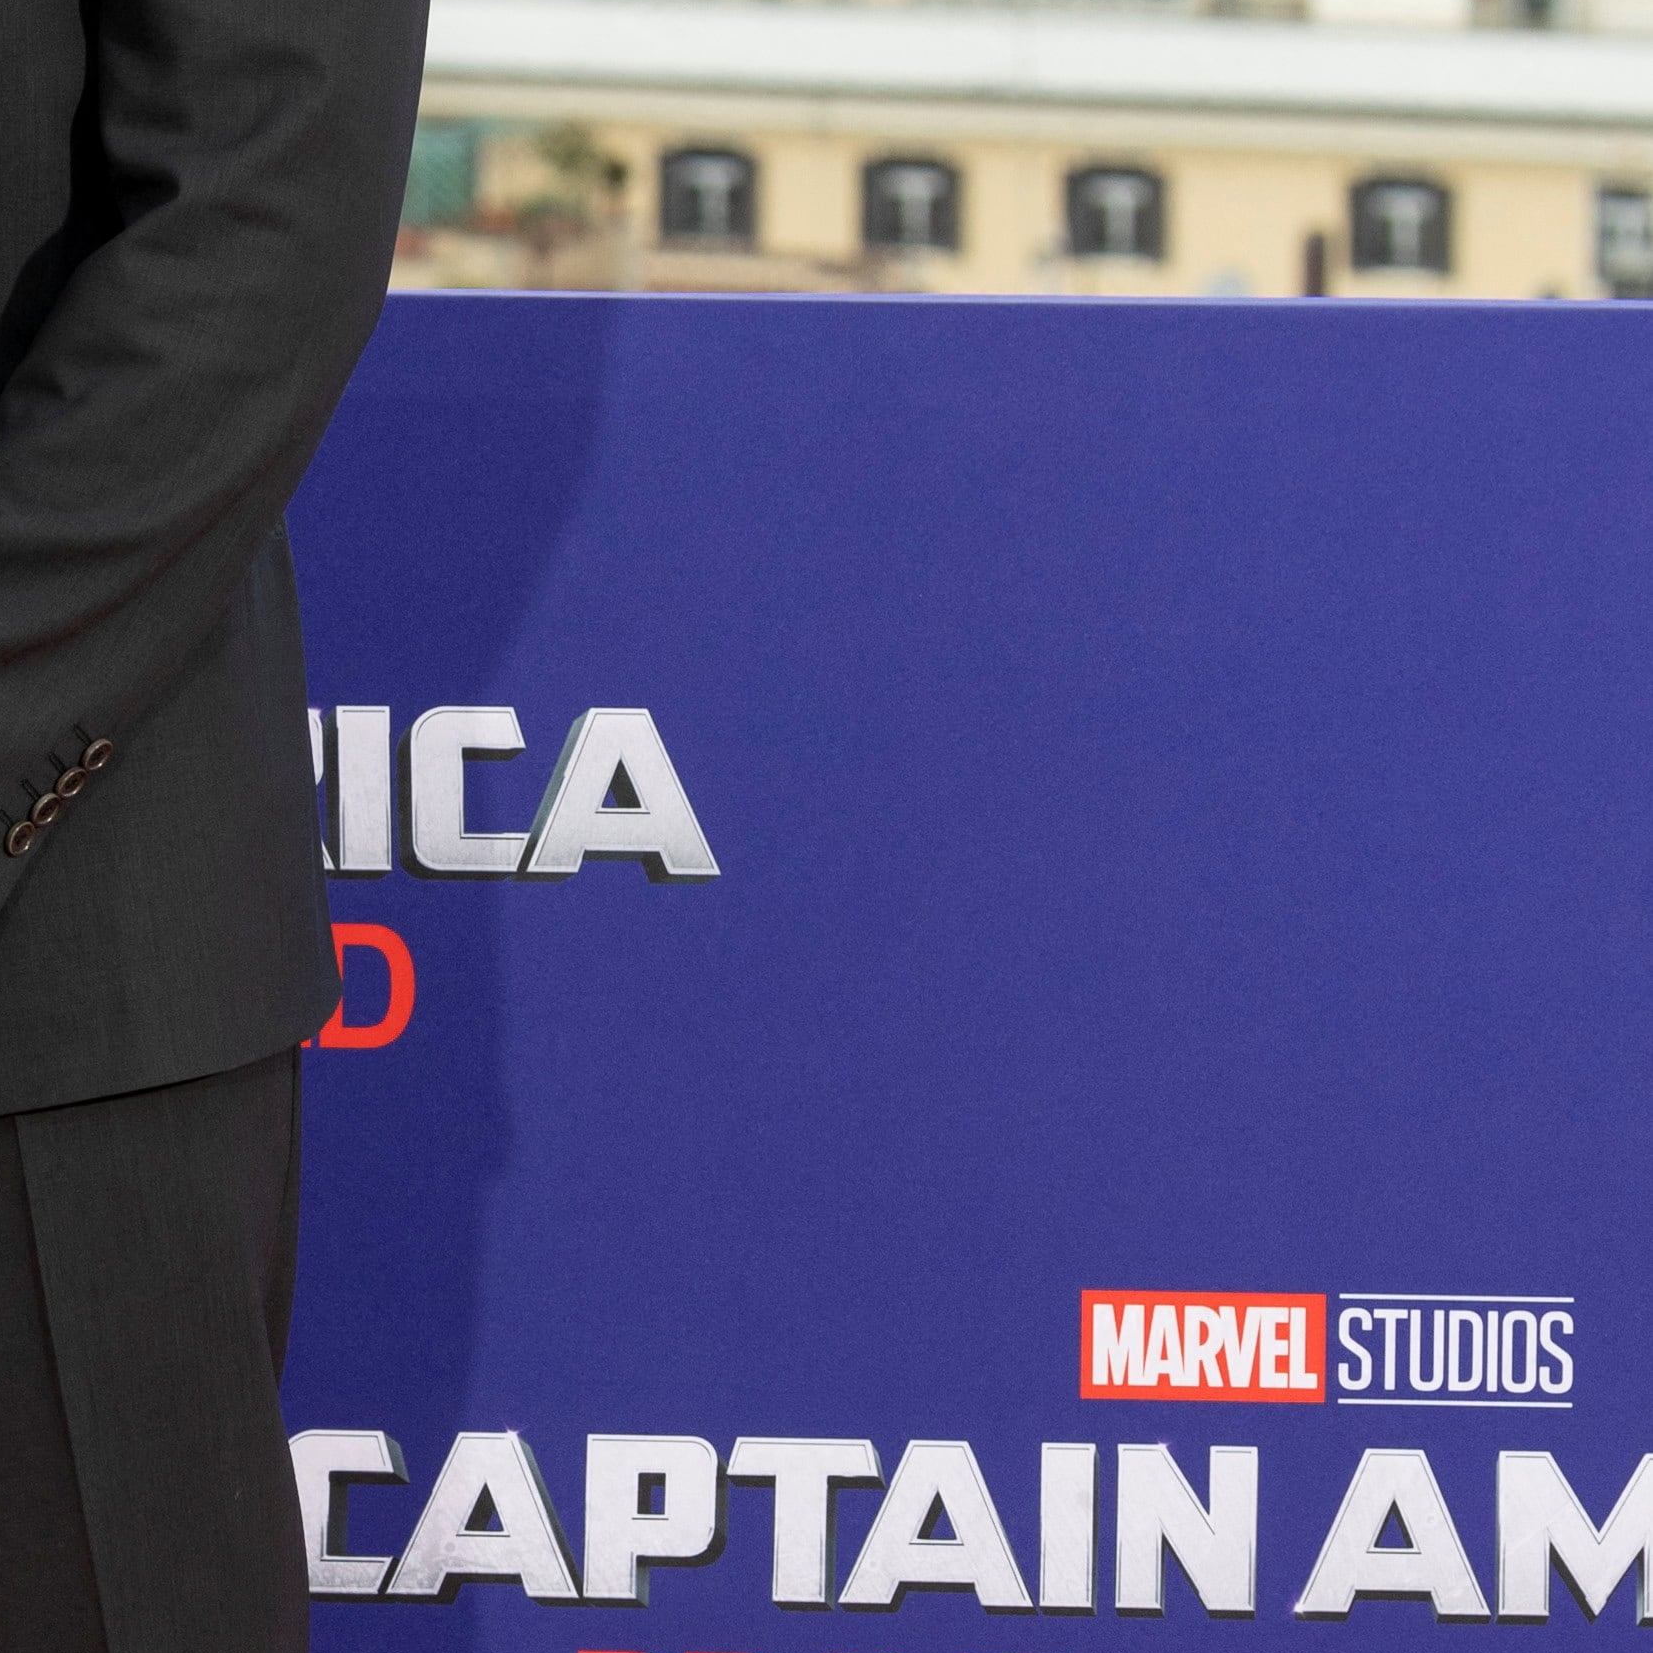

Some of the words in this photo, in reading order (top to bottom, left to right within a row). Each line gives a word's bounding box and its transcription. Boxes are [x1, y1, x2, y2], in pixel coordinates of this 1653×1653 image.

[307, 705, 721, 883] ICA
[1091, 1303, 1318, 1390] MARVEL
[1337, 1307, 1574, 1394] STUDIOS
[288, 1428, 1259, 1618] CAPTAIN
